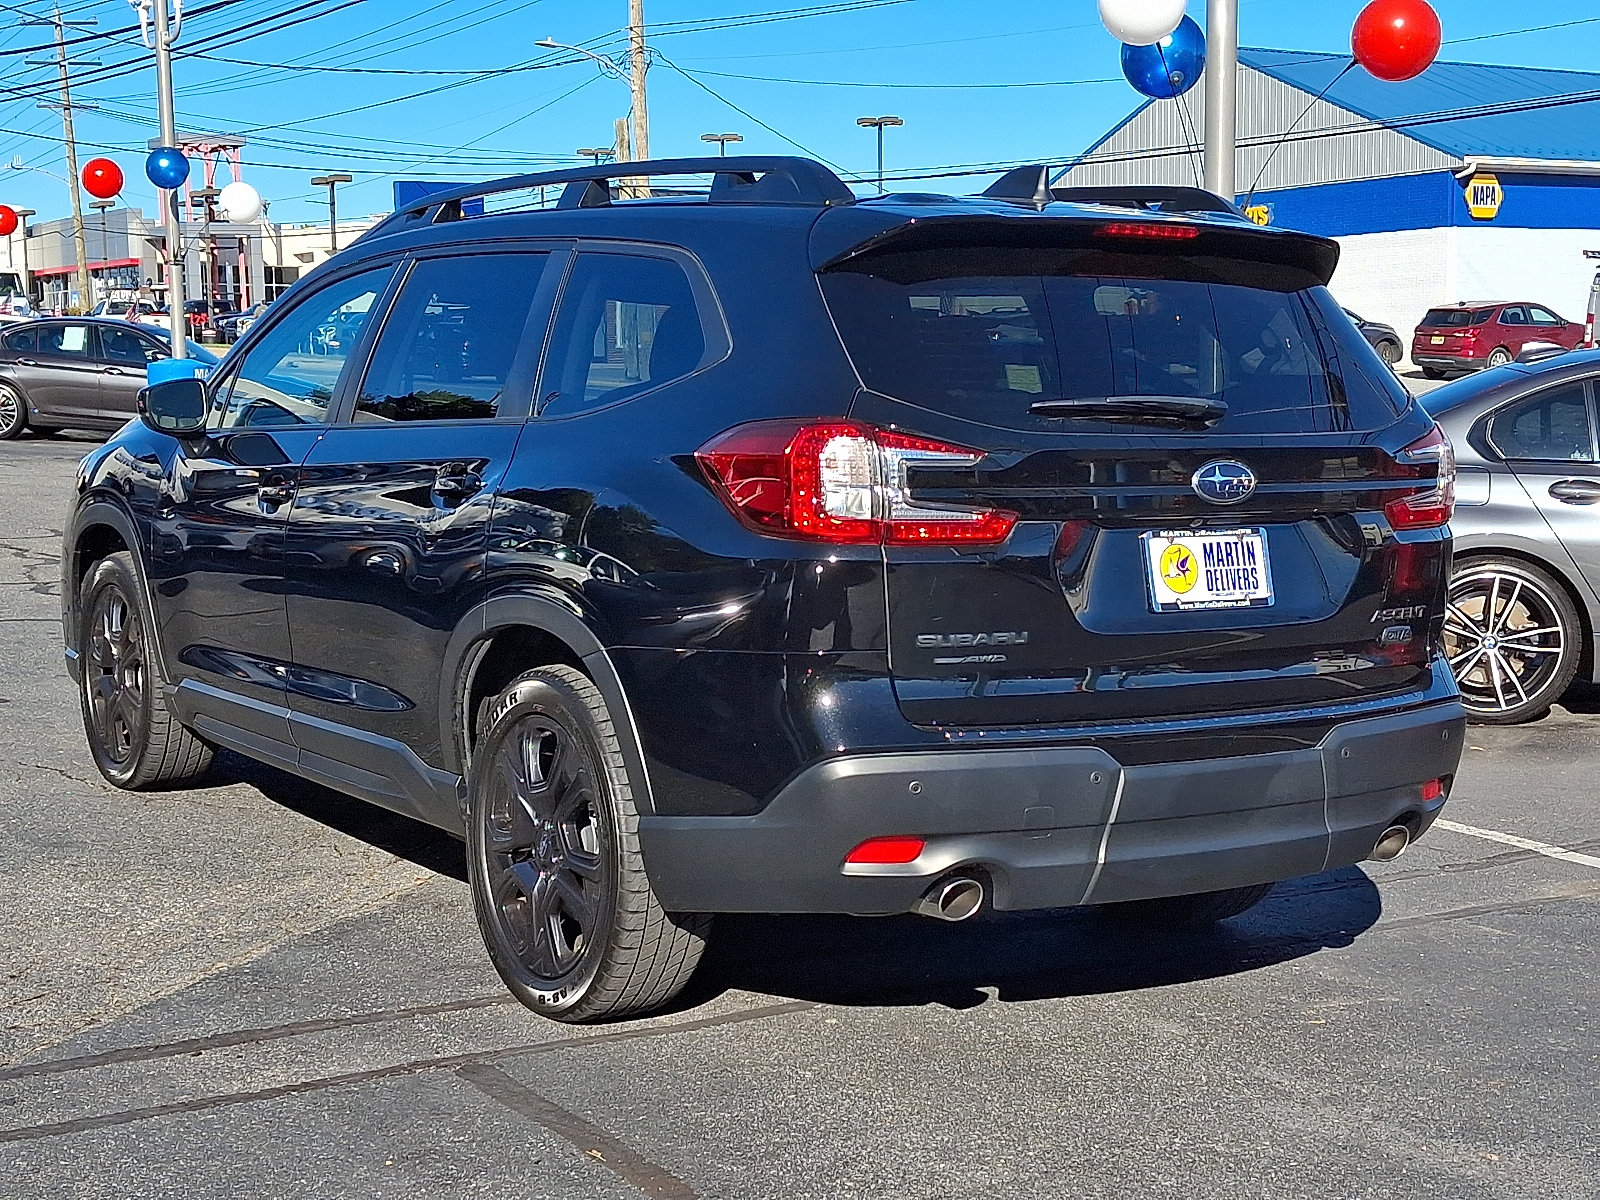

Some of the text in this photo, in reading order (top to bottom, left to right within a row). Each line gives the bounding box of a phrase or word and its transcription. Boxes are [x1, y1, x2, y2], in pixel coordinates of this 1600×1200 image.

[1472, 185, 1497, 206] NAPA
[1202, 541, 1257, 569] MARTIN
[1205, 567, 1260, 592] DELIVERS
[916, 631, 1029, 648] SUBARU
